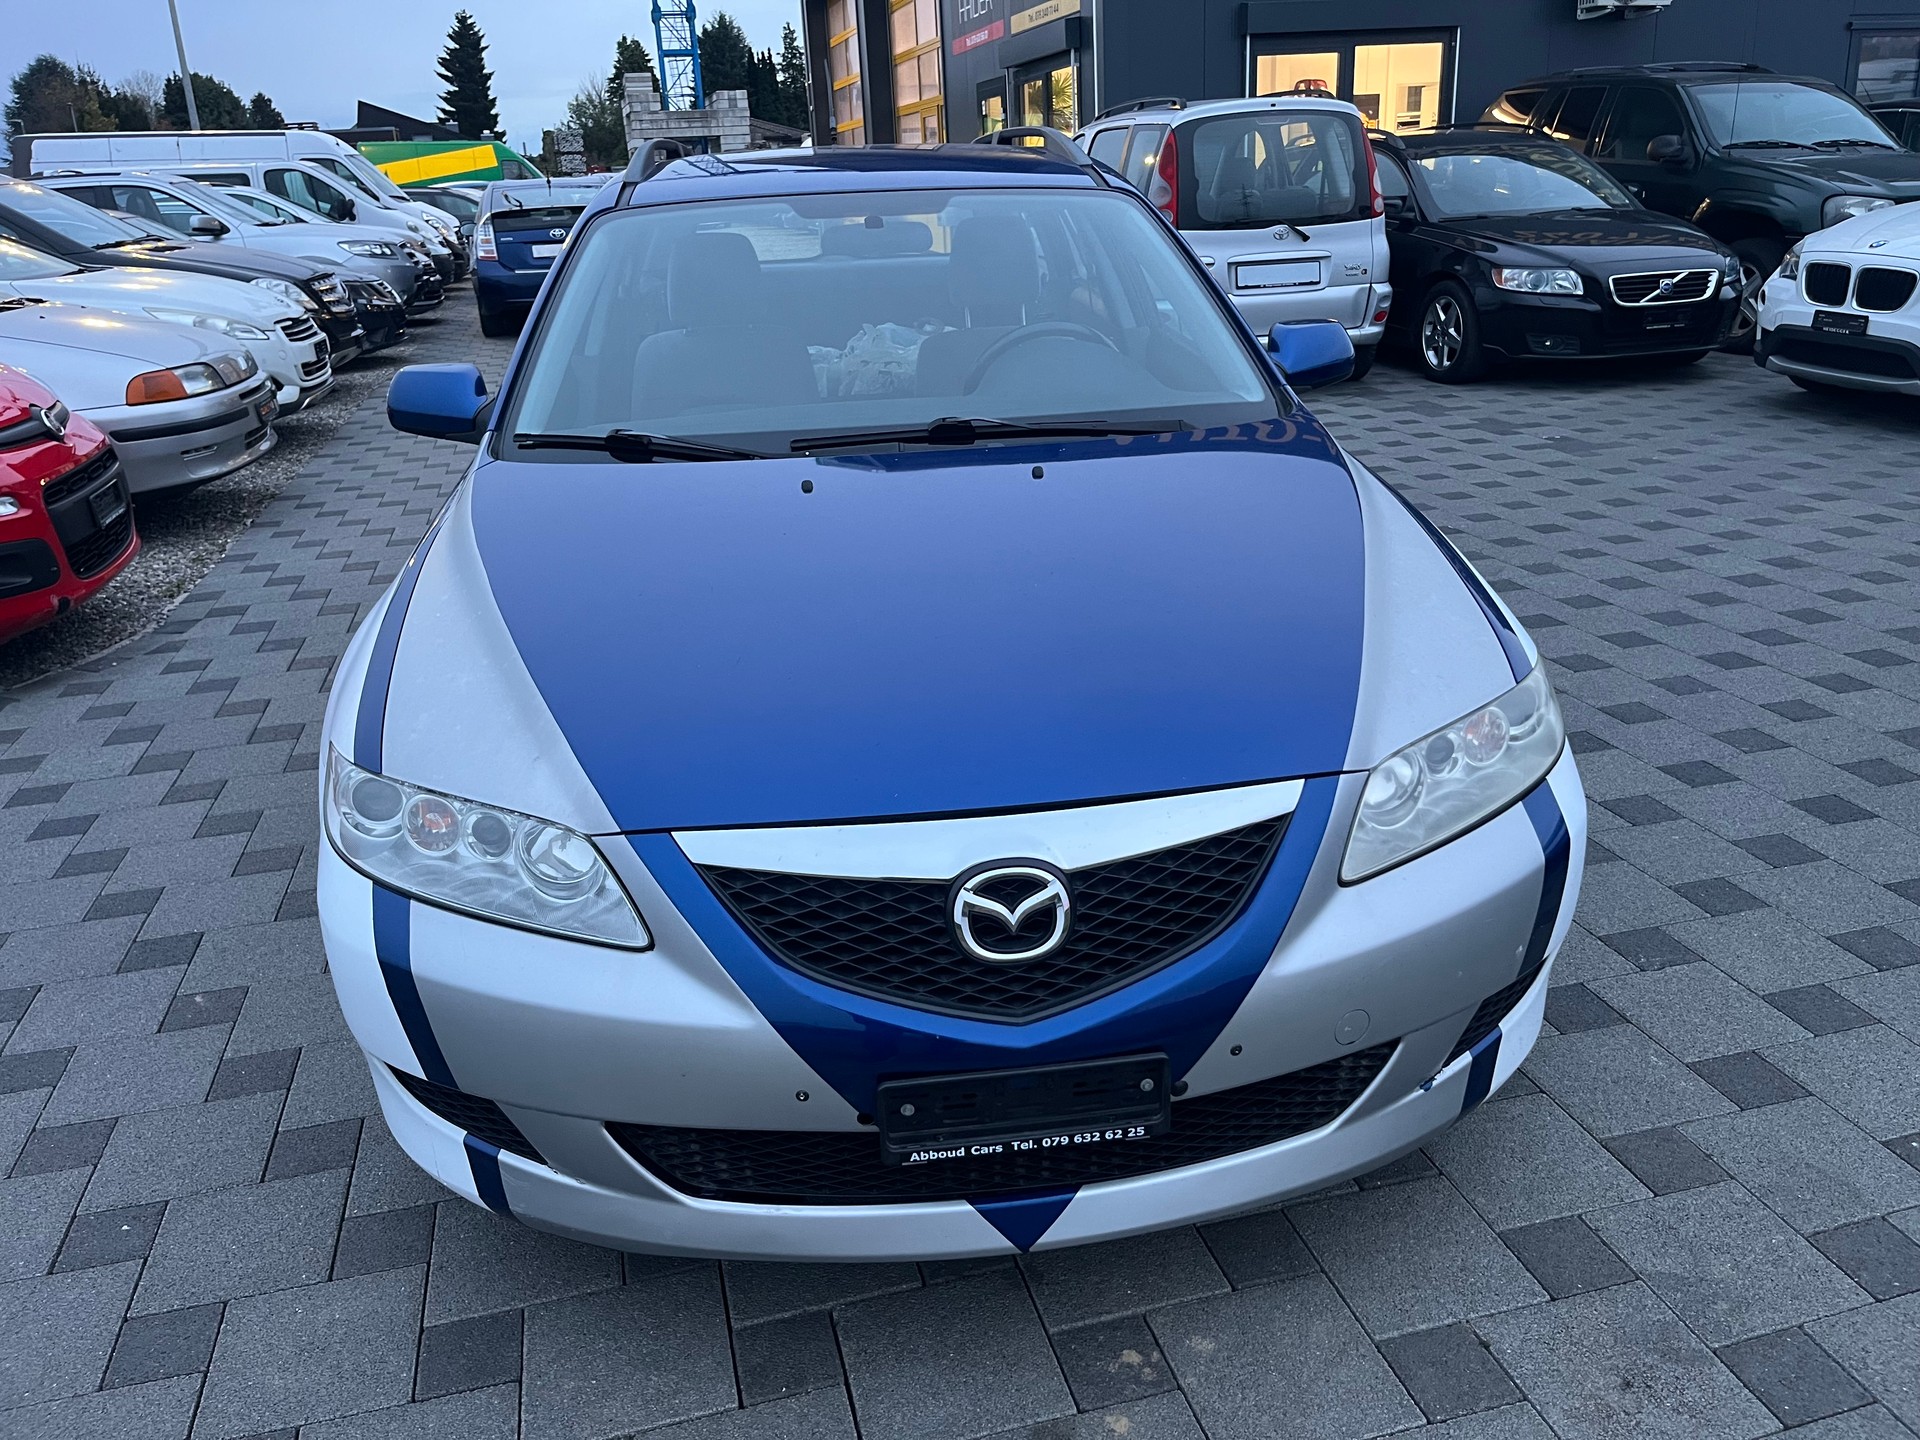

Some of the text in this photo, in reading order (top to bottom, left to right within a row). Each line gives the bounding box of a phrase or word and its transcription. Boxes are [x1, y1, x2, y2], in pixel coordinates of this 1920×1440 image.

[909, 1126, 1145, 1162] Abboud Cars Tel. 079 632 62 25
